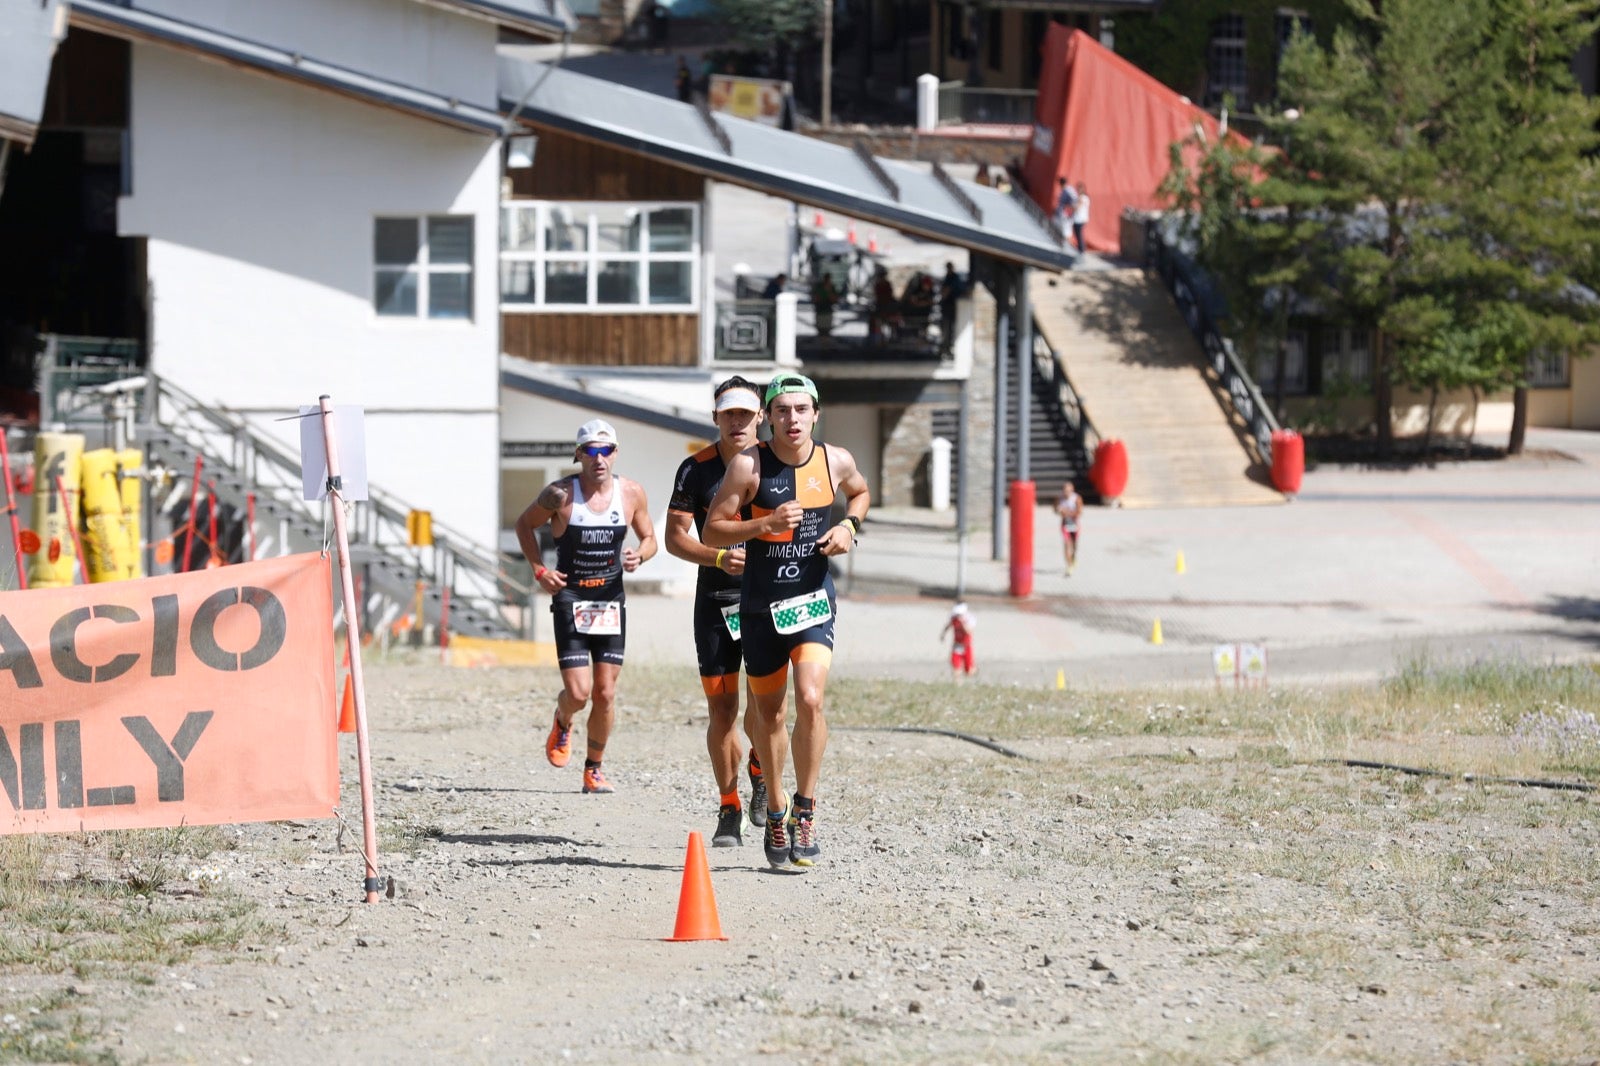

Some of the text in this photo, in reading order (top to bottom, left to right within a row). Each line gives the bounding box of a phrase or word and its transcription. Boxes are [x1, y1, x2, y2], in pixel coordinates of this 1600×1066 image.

[581, 530, 614, 544] MONTORO
[766, 542, 816, 558] JIMÉNEZ
[794, 605, 811, 623] 2
